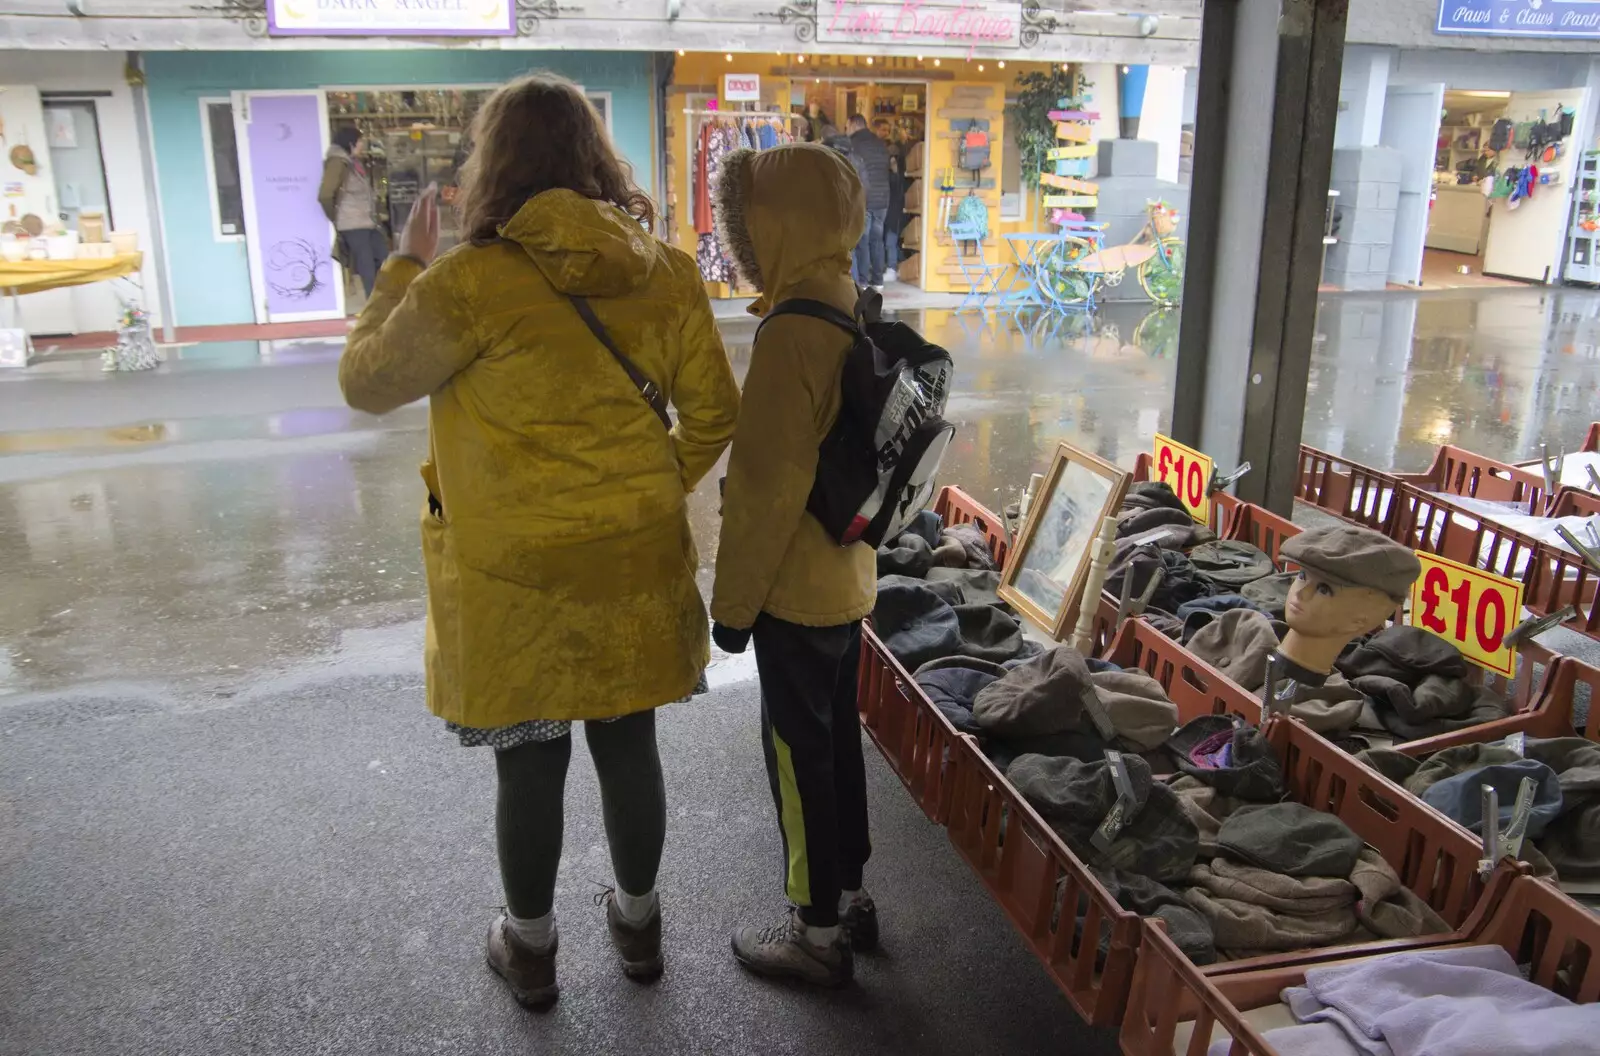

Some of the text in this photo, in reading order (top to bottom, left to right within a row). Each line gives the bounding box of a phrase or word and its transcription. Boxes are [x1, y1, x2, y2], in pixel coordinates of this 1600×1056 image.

[891, 0, 1014, 62] Boutique
[1452, 6, 1600, 29] Paws & Claws Pantr
[1158, 445, 1203, 509] £10
[1420, 566, 1506, 653] £10
